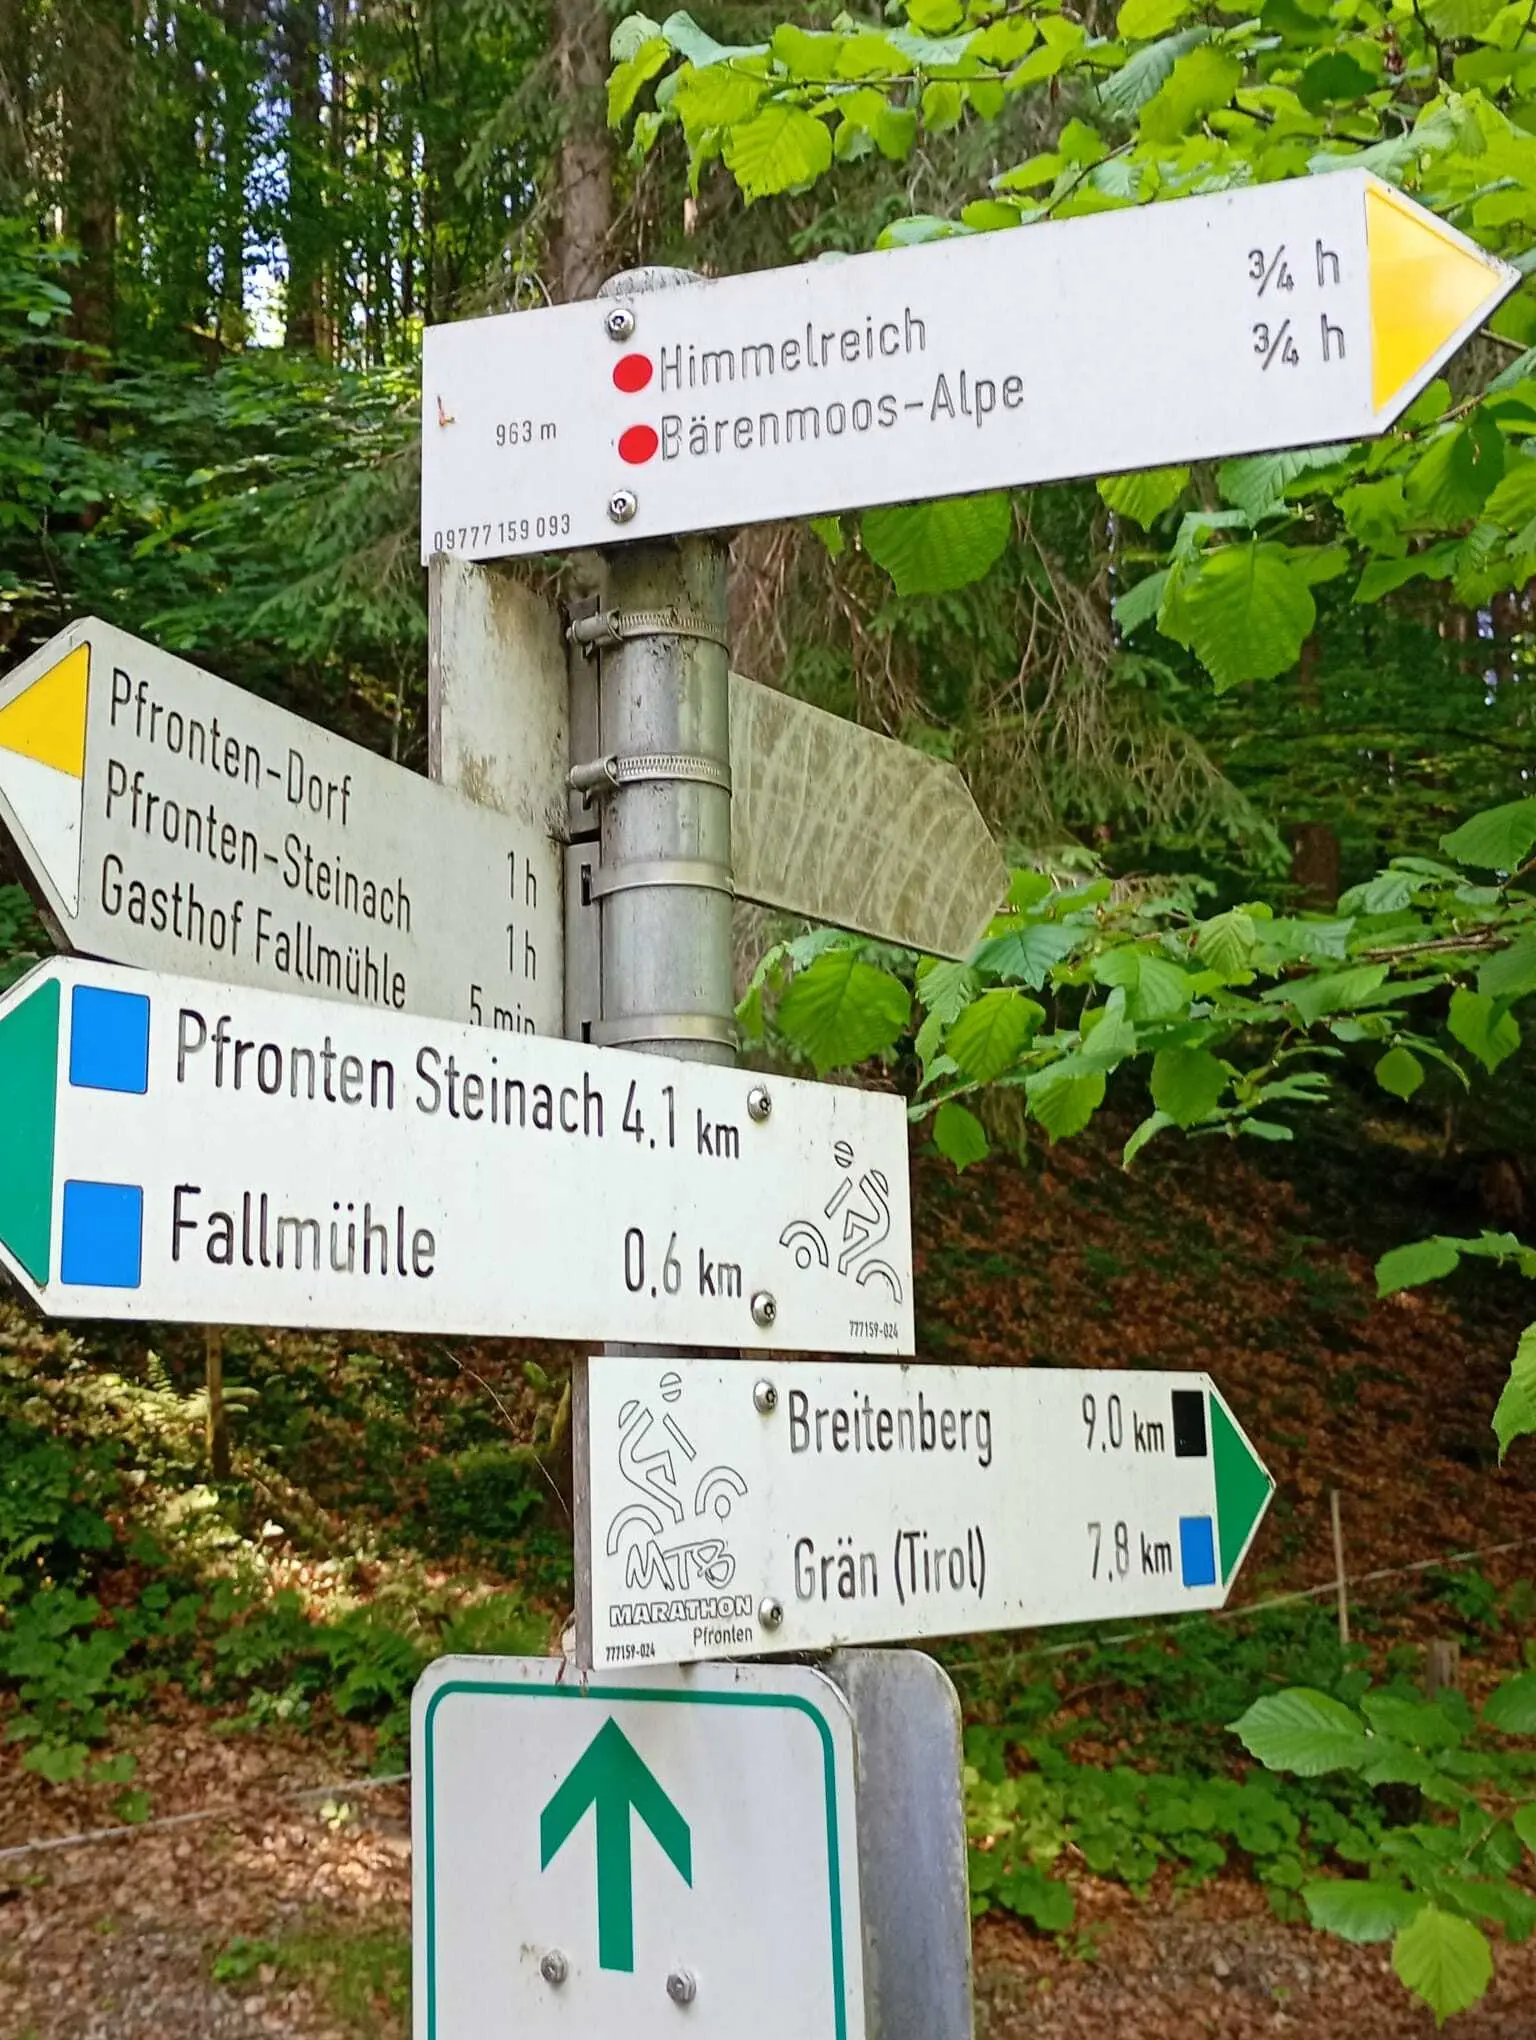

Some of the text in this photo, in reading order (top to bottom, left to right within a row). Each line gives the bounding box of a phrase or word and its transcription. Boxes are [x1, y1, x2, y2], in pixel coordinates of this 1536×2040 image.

[660, 307, 926, 392] Himmelreich
[1316, 238, 1340, 287] h
[496, 419, 557, 446] 963 m
[661, 370, 1024, 461] Bärenmoos-Alpe
[1321, 313, 1345, 361] h
[498, 519, 529, 543] 159
[537, 513, 570, 538] 093
[110, 667, 537, 908] Pfronten-Dorf 1 h
[106, 759, 536, 980] Pfronten-Steinach 1 h
[101, 854, 244, 955] Gasthof
[256, 908, 406, 1009] Fallmühle
[470, 984, 482, 1026] 5
[177, 1008, 394, 1110] Pfronten
[415, 1046, 604, 1138] Steinach
[697, 1108, 740, 1159] km
[172, 1184, 436, 1278] Fallmühle
[699, 1248, 741, 1298] km
[788, 1389, 993, 1468] Breitenberg
[1134, 1410, 1165, 1453] km
[610, 1594, 752, 1627] MARATHON
[626, 1539, 736, 1591] MTB
[794, 1537, 878, 1600] Grän
[894, 1525, 986, 1605] (Tirol)
[1141, 1531, 1172, 1576] km
[693, 1623, 753, 1647] Pfronten
